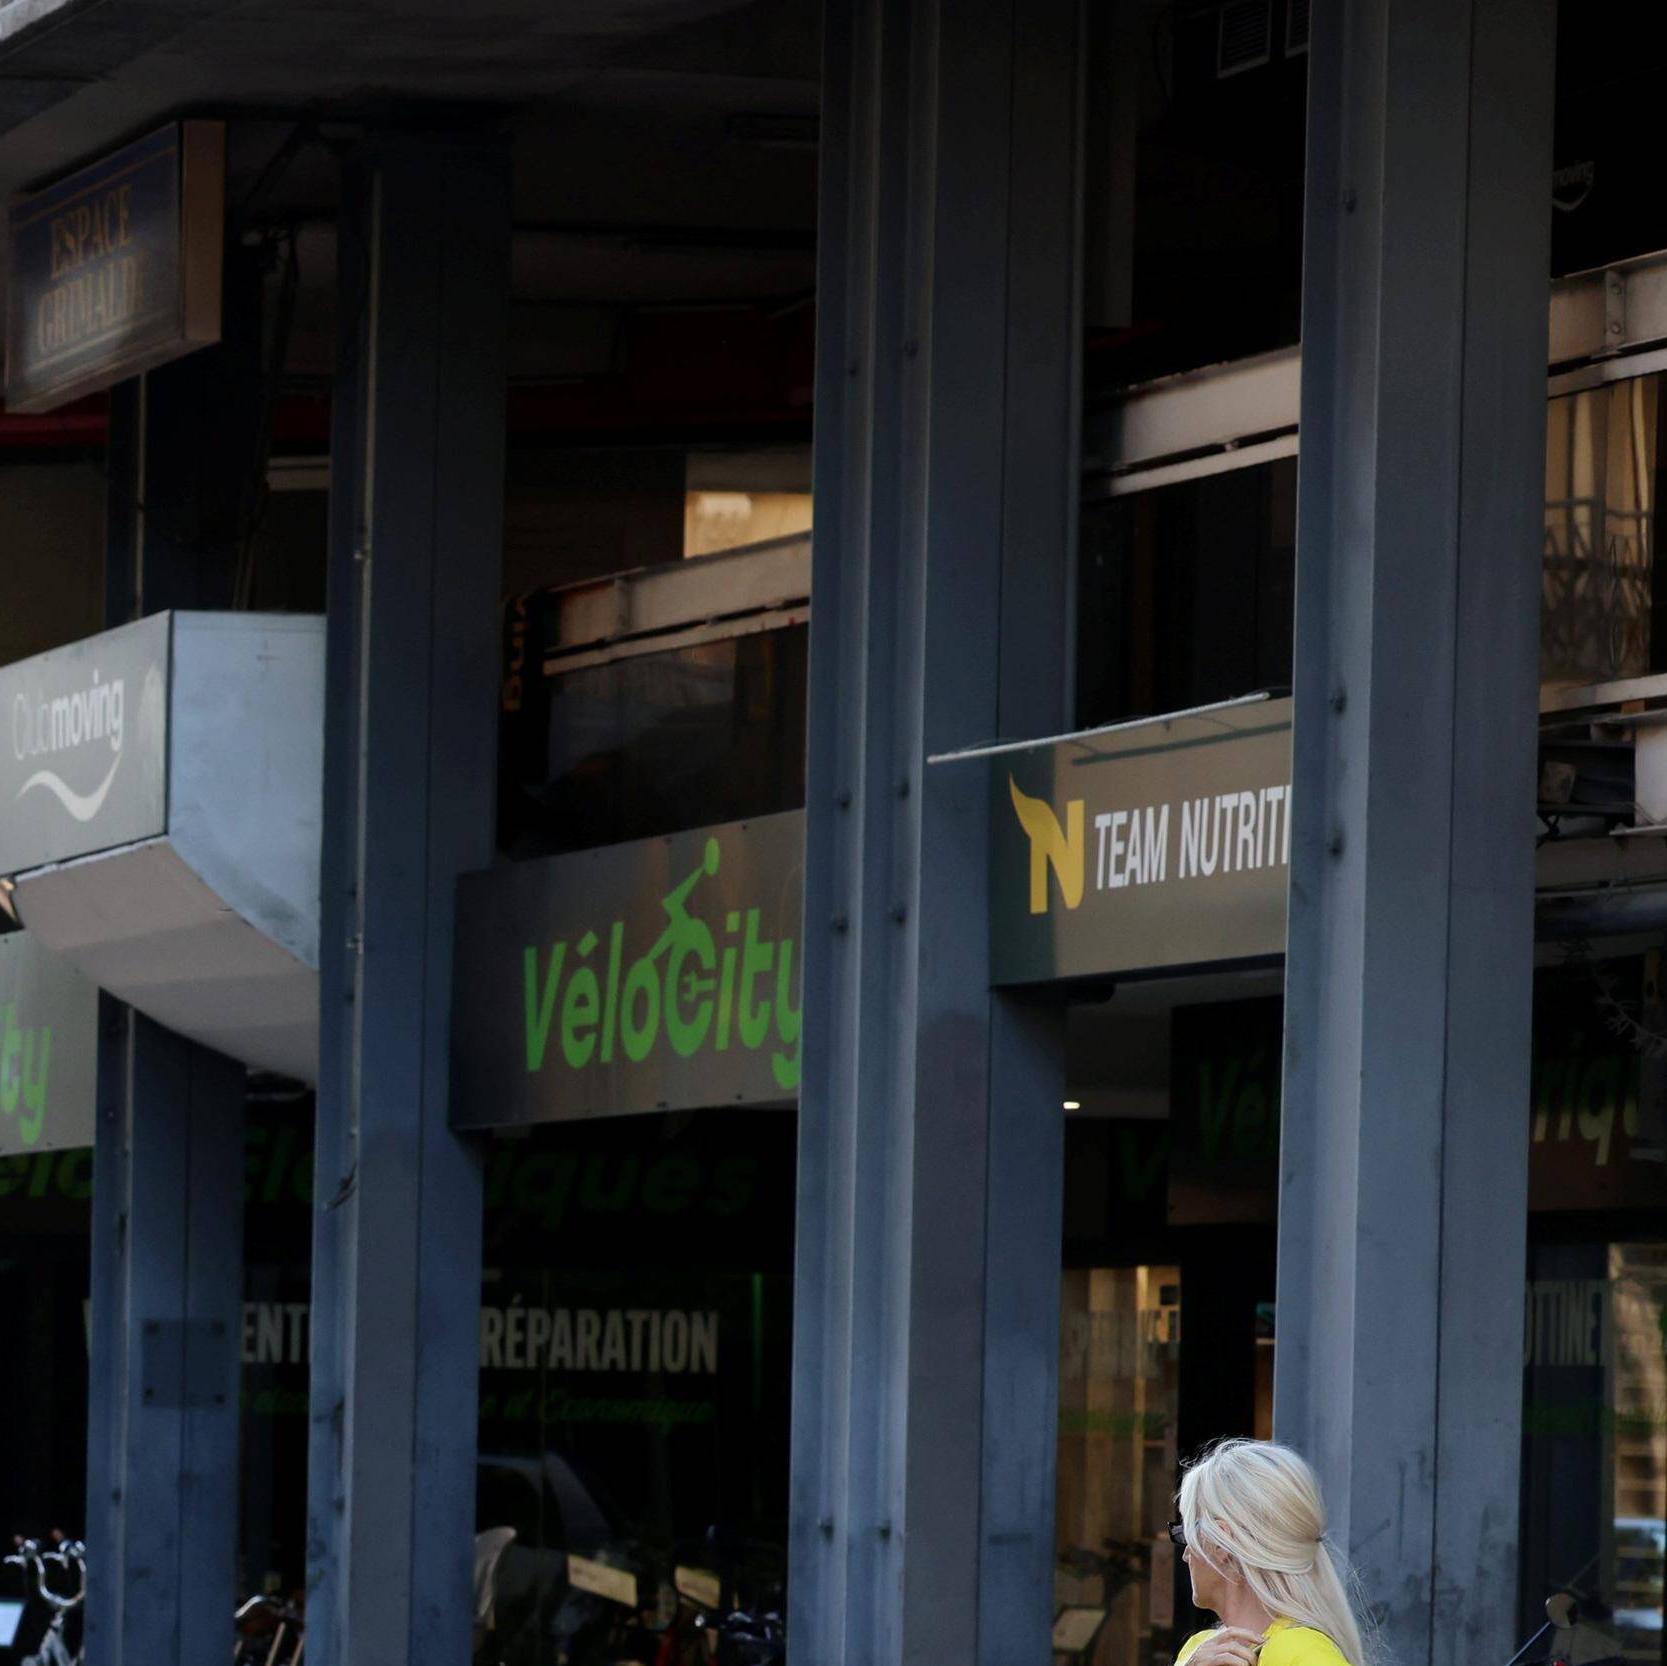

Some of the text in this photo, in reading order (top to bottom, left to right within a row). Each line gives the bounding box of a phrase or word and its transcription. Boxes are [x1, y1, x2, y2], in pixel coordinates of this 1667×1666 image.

[50, 184, 133, 280] ESPACE
[1094, 804, 1169, 890] TEAM
[480, 1292, 719, 1376] RÉPARATION
